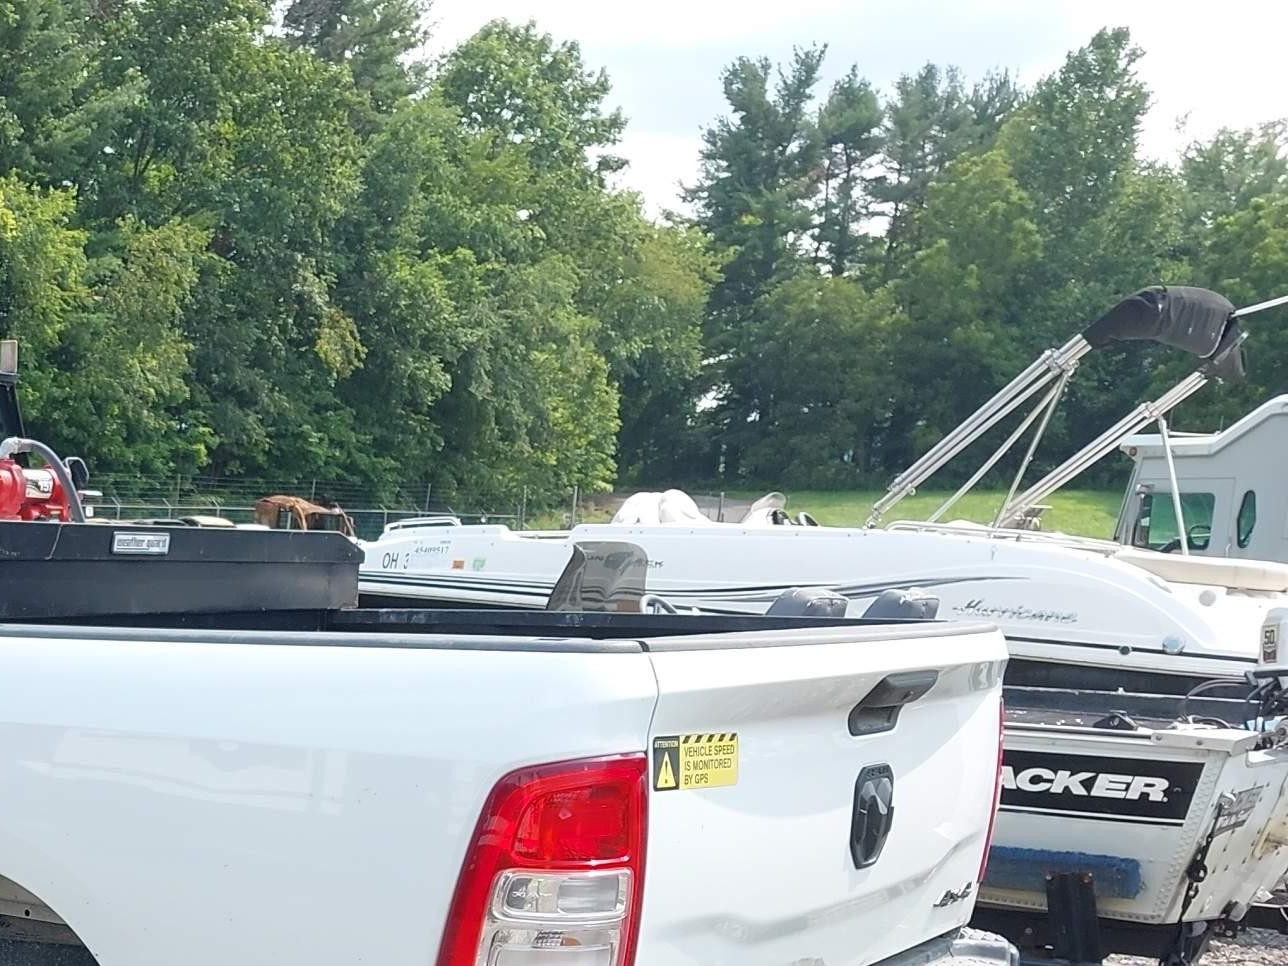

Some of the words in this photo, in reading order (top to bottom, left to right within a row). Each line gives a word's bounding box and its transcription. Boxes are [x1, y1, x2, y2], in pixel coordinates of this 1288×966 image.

[382, 552, 399, 569] OH
[951, 599, 1079, 623] Hurricane
[1264, 629, 1275, 645] 50
[683, 746, 712, 758] VEHICLE
[714, 744, 734, 756] SPEED
[684, 760, 691, 771] IS
[693, 758, 732, 770] MONITORED
[684, 774, 693, 785] BY
[695, 773, 709, 784] GPS
